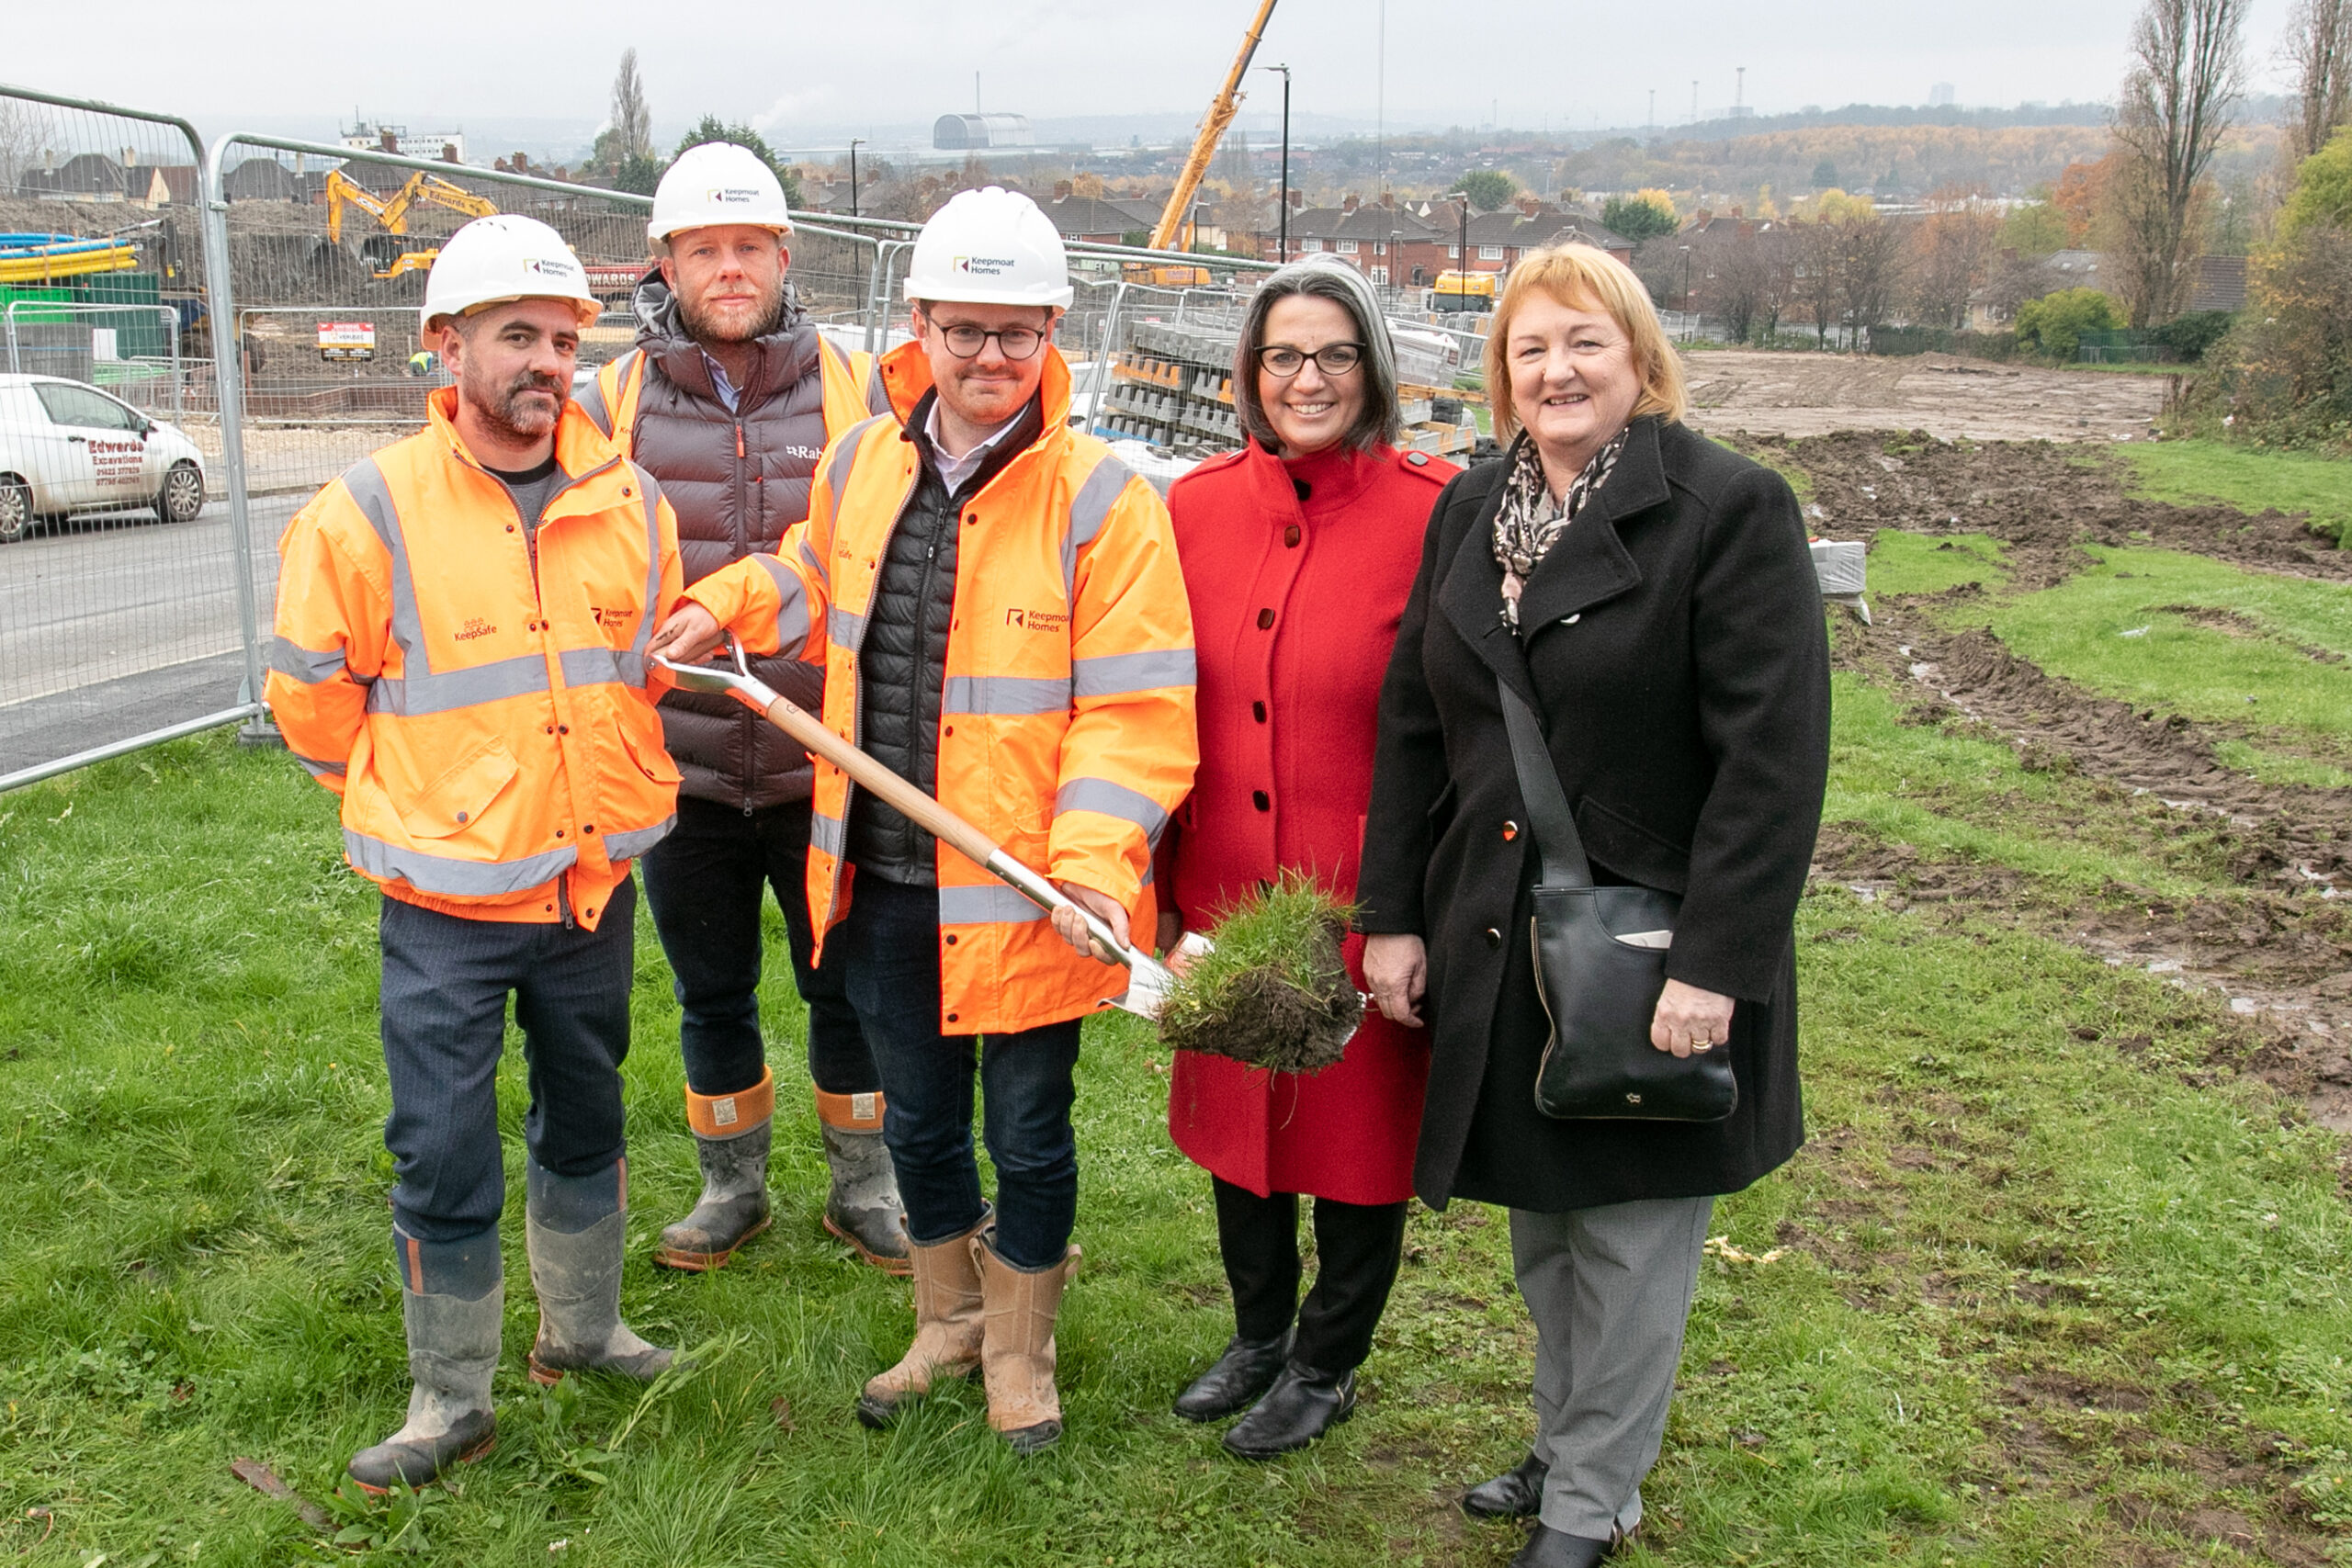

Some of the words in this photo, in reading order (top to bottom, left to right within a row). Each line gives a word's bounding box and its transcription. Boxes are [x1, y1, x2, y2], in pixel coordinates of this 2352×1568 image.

[429, 190, 465, 208] Edwards
[541, 259, 575, 273] Keepmoat
[971, 256, 1014, 266] Keepmoat
[542, 267, 568, 277] Homes
[971, 266, 1001, 276] Homes
[88, 439, 144, 454] Edwards
[798, 446, 823, 459] Rab
[93, 456, 143, 465] Excavations
[1028, 610, 1070, 623] Keepmoa
[454, 625, 497, 641] KeepSafe
[1027, 621, 1059, 632] Homes
